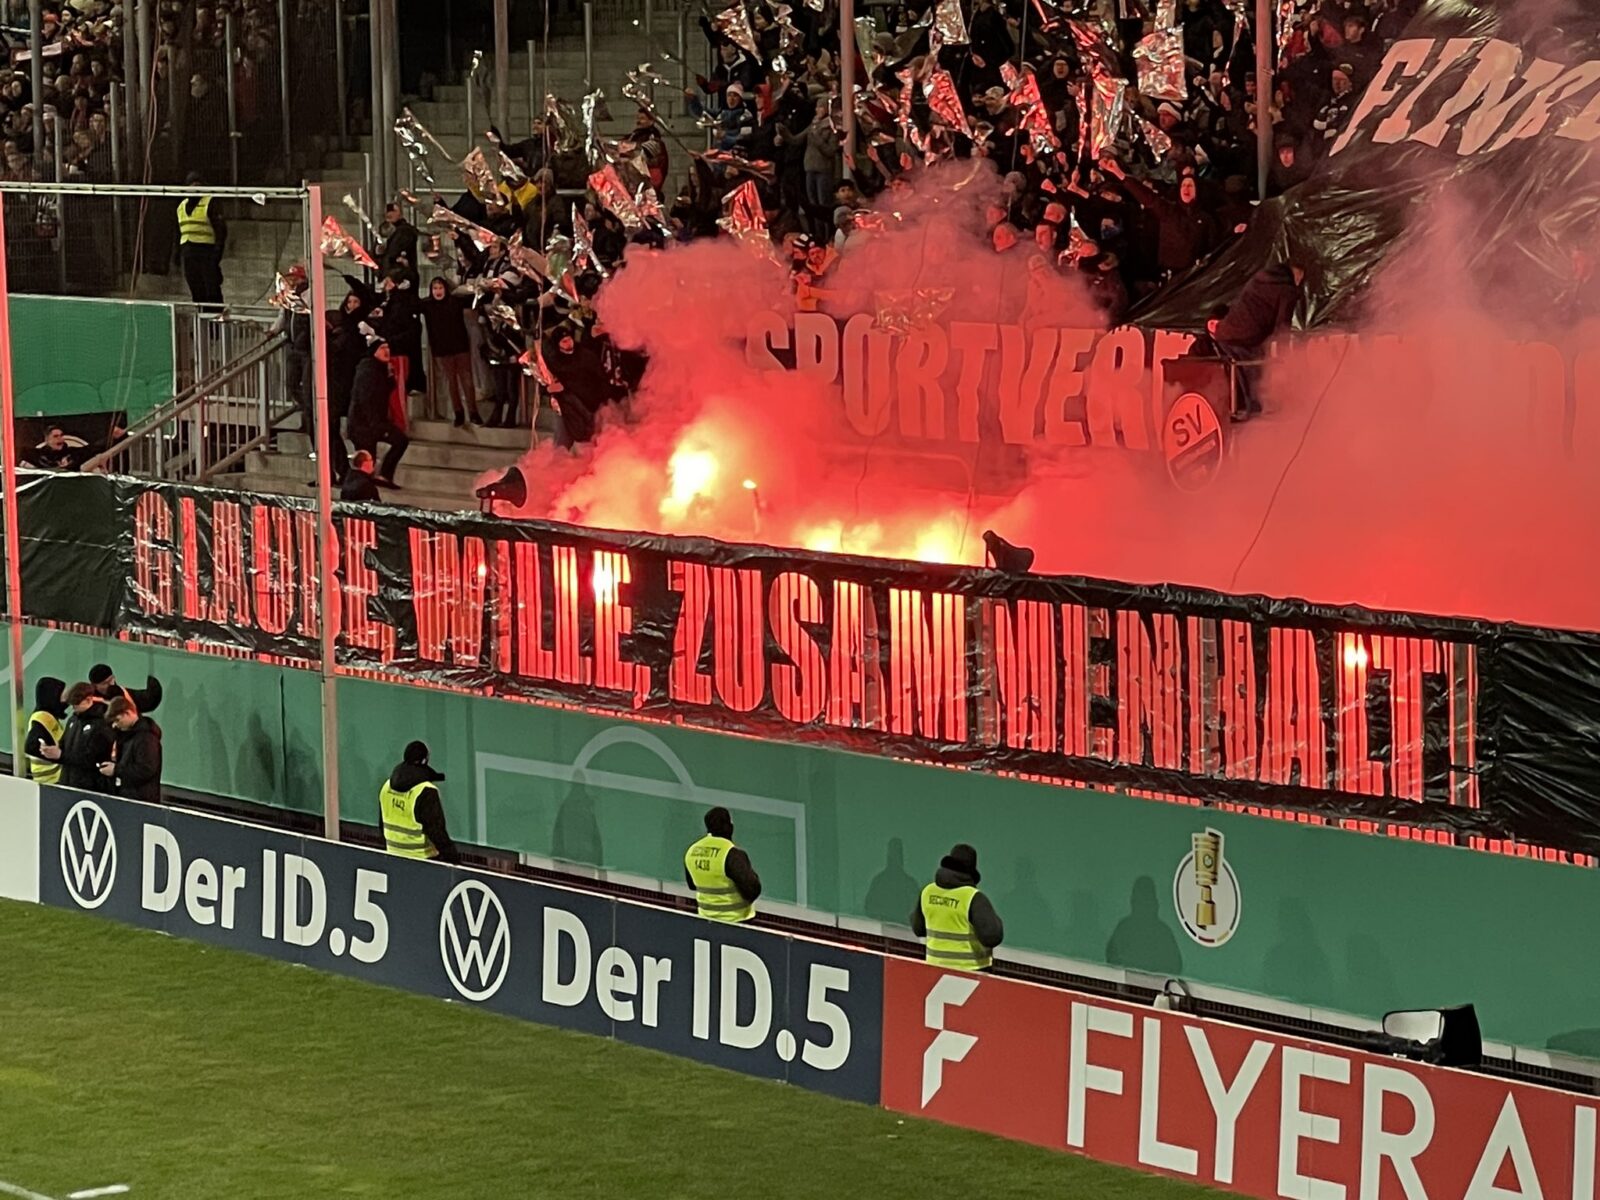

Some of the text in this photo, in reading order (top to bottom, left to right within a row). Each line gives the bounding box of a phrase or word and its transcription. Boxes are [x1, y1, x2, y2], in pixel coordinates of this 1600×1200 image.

[1172, 403, 1202, 447] SV
[141, 823, 246, 929] Der
[262, 849, 389, 964] ID.5
[929, 894, 960, 909] SECURITY
[542, 906, 672, 1028] Der
[692, 938, 852, 1071] ID.5
